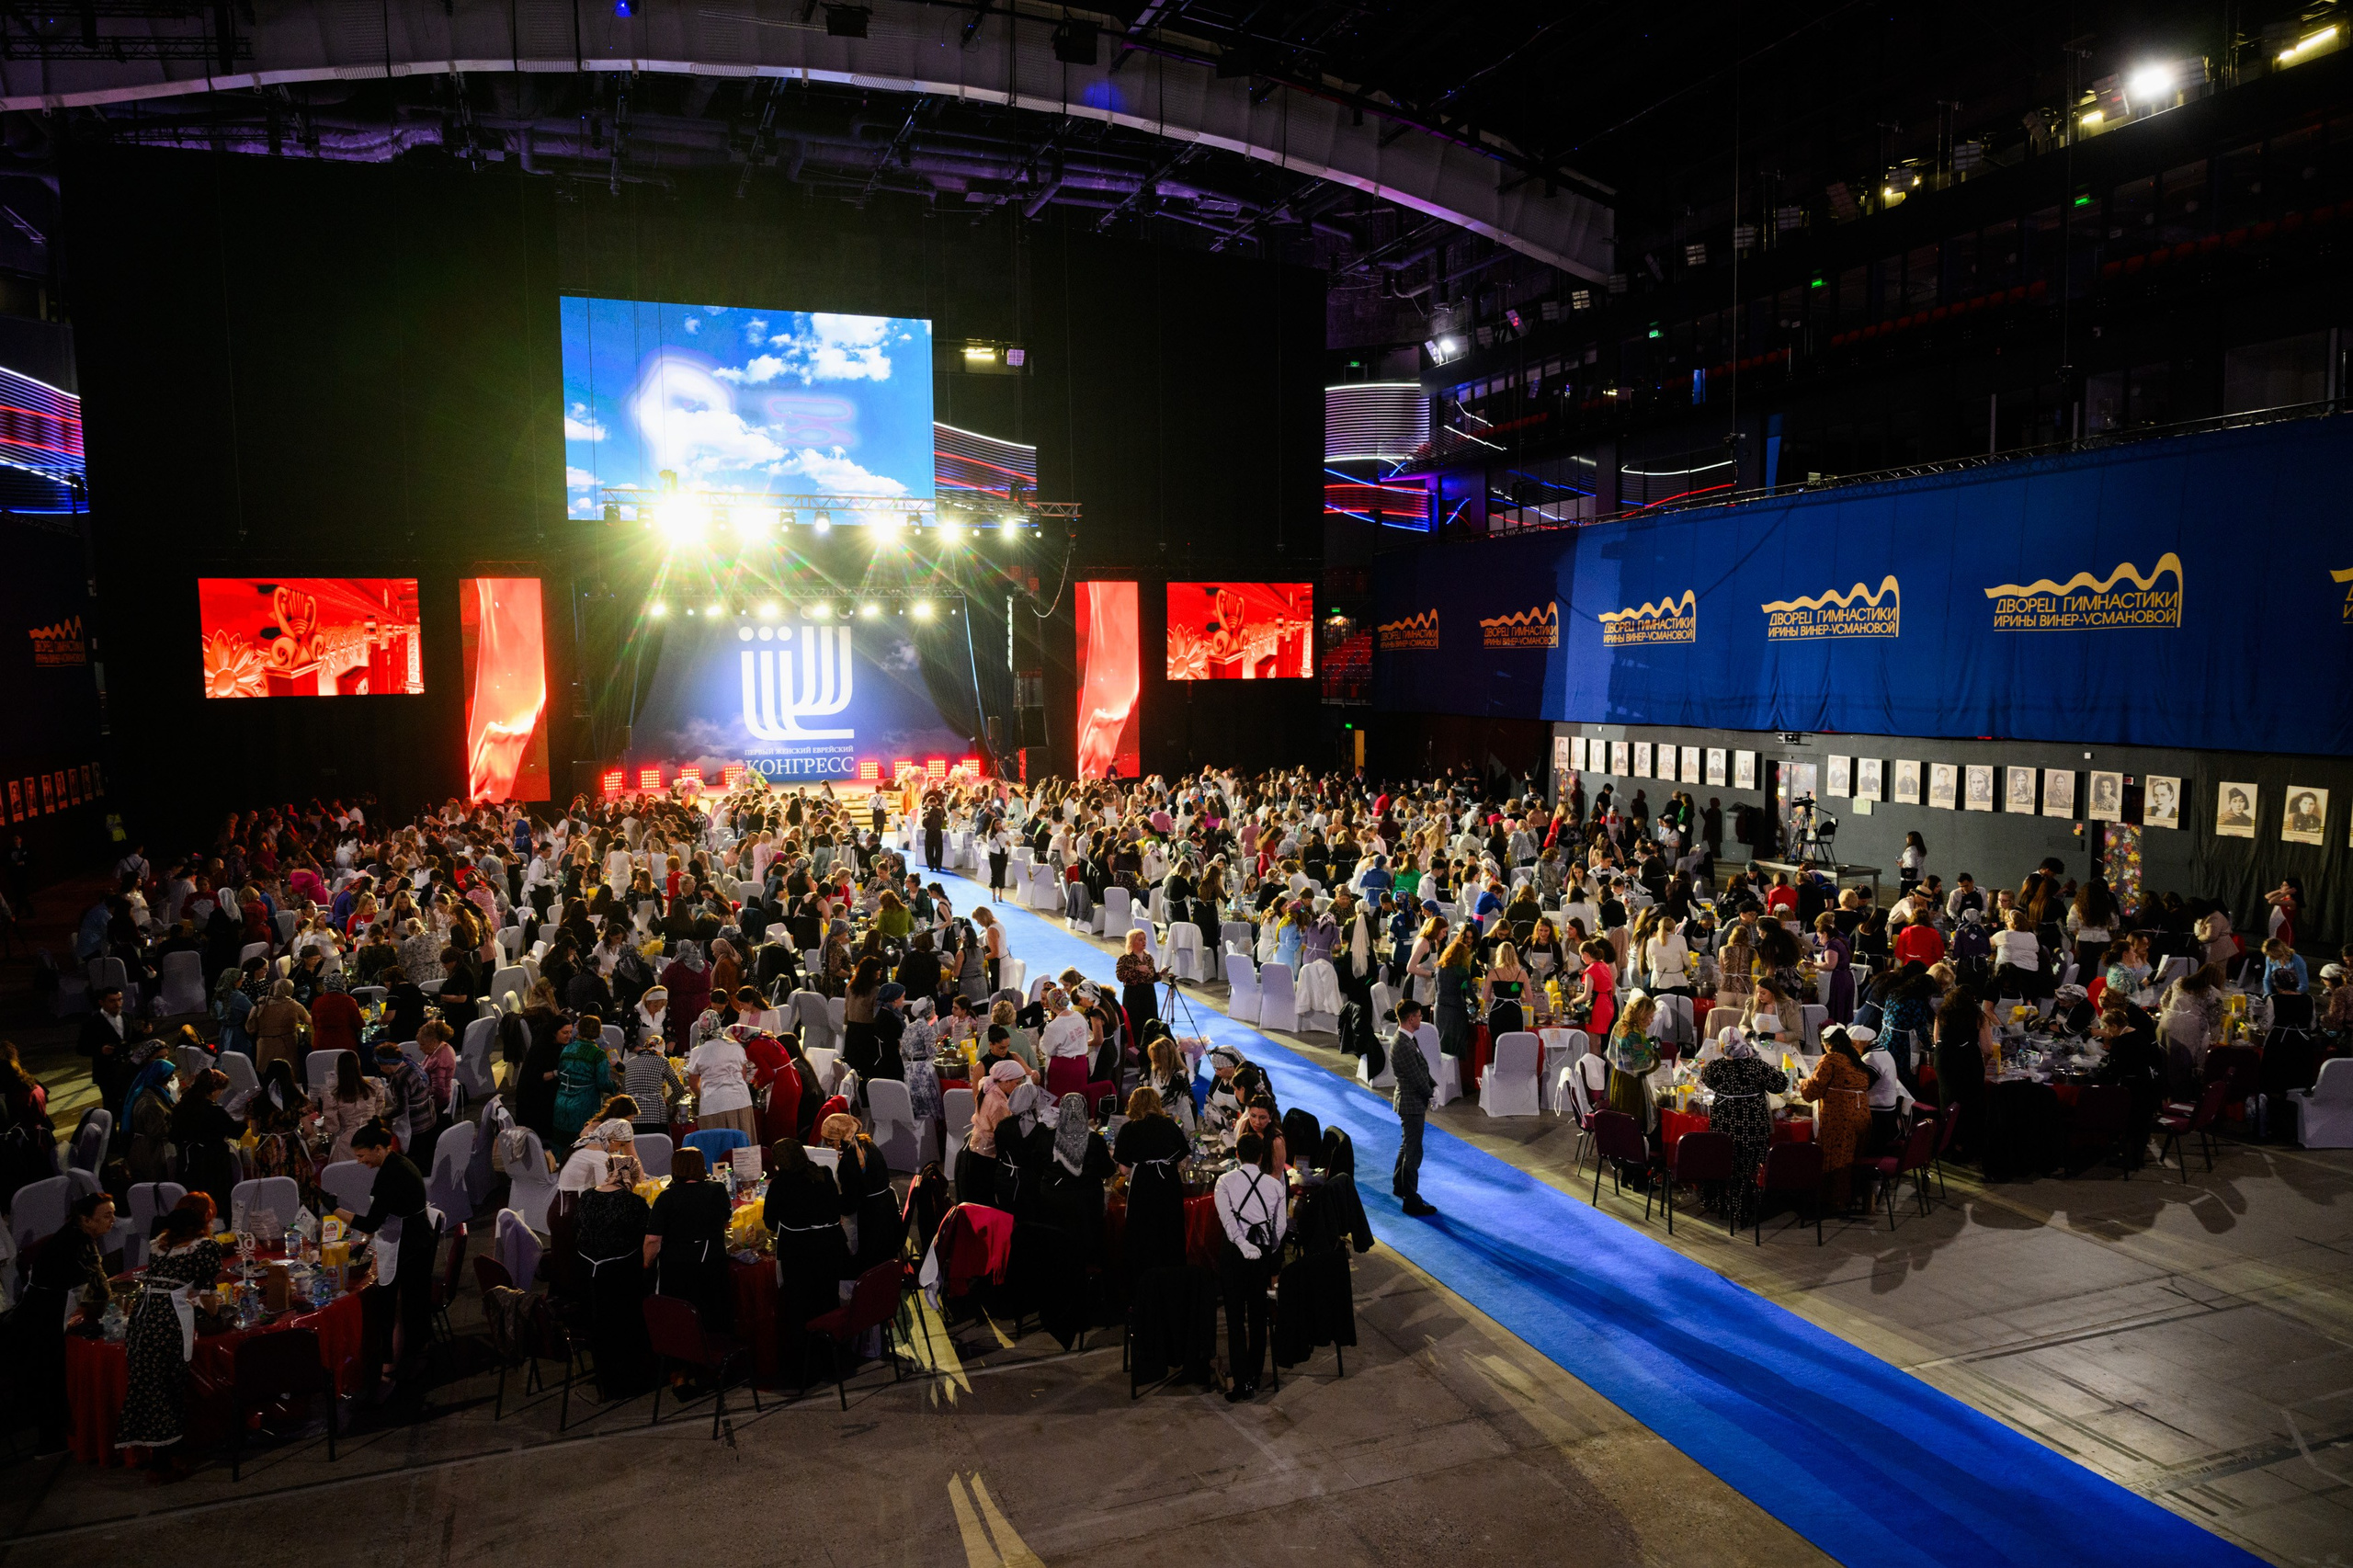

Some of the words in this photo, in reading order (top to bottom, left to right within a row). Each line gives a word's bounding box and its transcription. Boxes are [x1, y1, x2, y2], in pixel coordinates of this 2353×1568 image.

[1995, 597, 2056, 614] ДВОРЕЦ
[2063, 592, 2178, 611] ГИМНАСТИКИ
[1768, 611, 1813, 626] ДВОРЕЦ
[1816, 607, 1896, 623] ГИМНАСТИКИ
[1994, 615, 2037, 627] ИРИНЫ
[2040, 608, 2177, 627] ВИНЕР-УСМАНОВОЙ
[1483, 627, 1509, 638] ДВОРЕЦ
[1511, 625, 1557, 637] ГИМНАСТИКИ
[1604, 620, 1635, 634] ДВОРЕЦ
[1637, 617, 1694, 631] ГИМНАСТИКИ
[1768, 626, 1799, 637] ИРИНЫ
[1800, 621, 1895, 636] ВИНЕР-УСМАНОВОЙ
[1603, 634, 1625, 643] ИРИНЫ
[1626, 629, 1693, 642] ВИНЕР-УСМАНОВОЙ
[745, 747, 774, 756] ПЕРВЫЙ
[775, 746, 812, 755] ЖЕНСКИЙ
[813, 745, 854, 754] ЕВРЕЙСКИЙ
[745, 756, 854, 775] КОНГРЕСС
